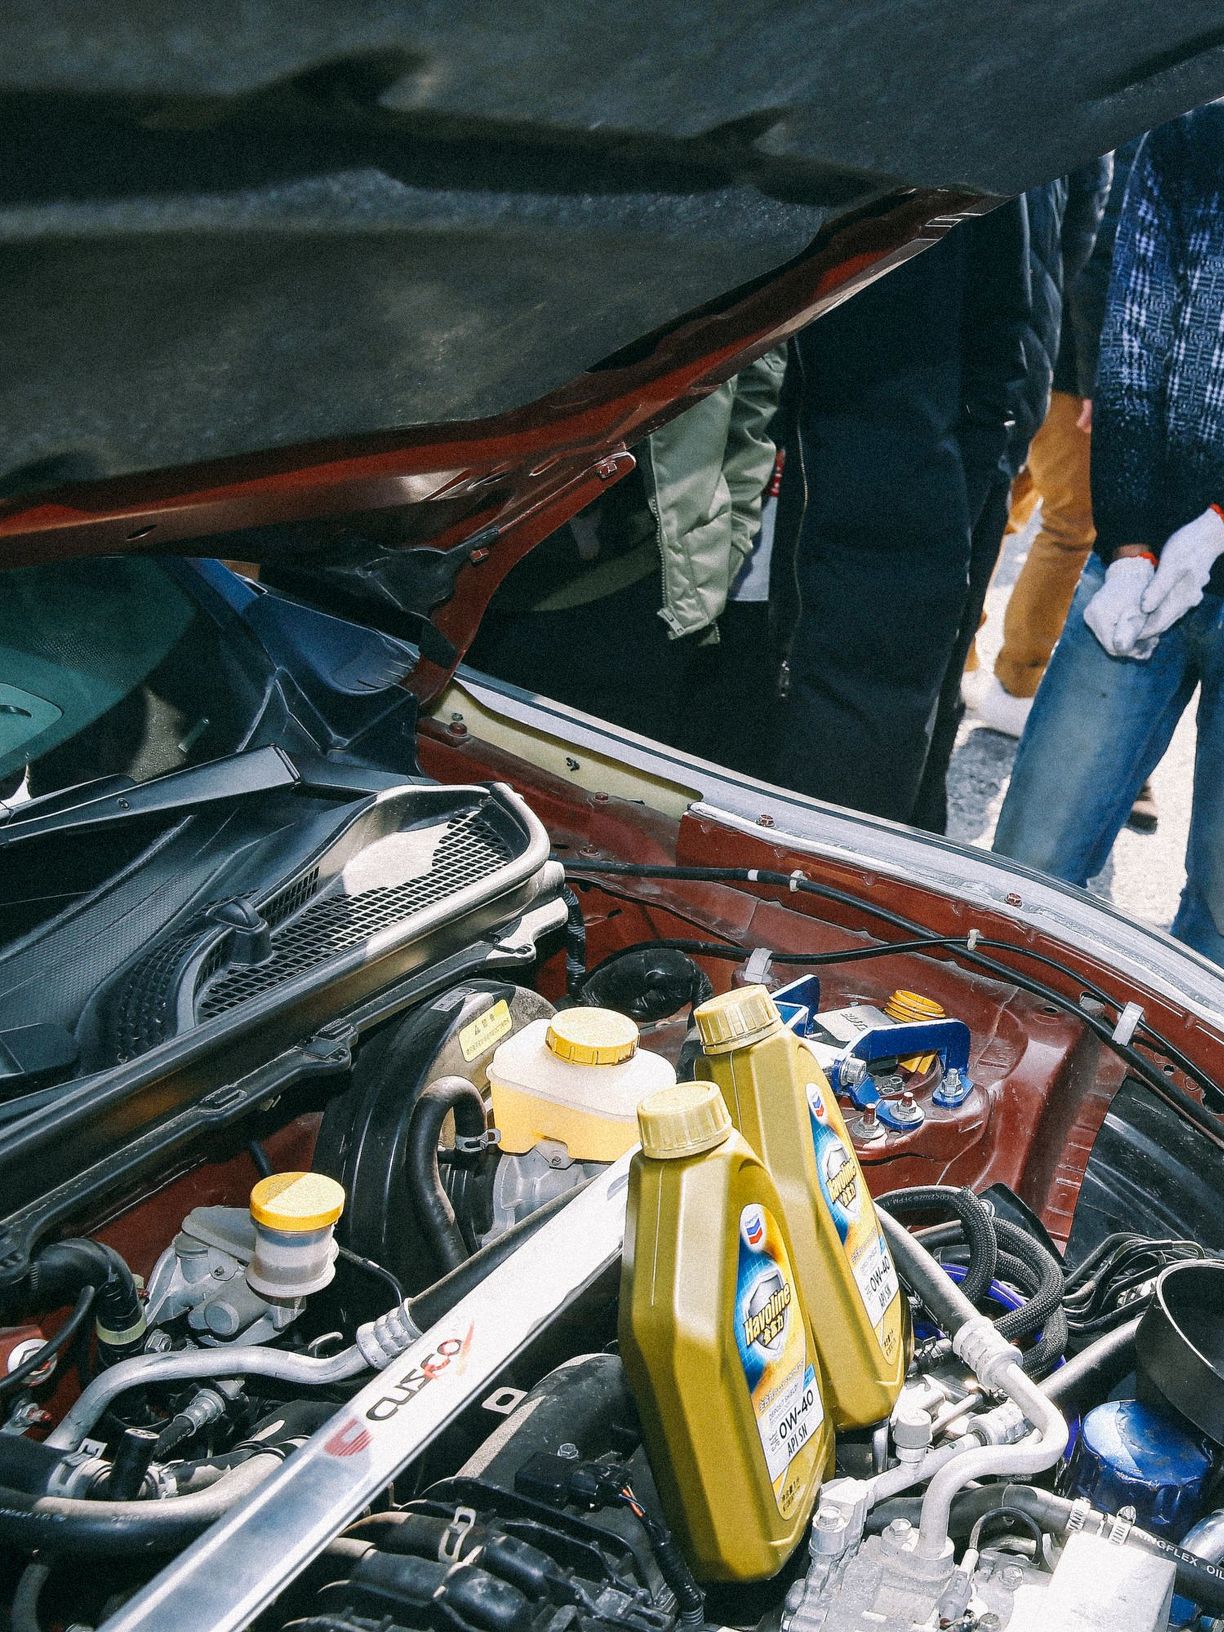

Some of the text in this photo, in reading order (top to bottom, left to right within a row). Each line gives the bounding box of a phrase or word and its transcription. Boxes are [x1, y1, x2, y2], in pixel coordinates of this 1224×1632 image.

[743, 1283, 791, 1348] Havoline
[366, 1338, 463, 1421] CUSCO
[779, 1389, 814, 1439] 0W-40
[787, 1423, 808, 1457] API SN
